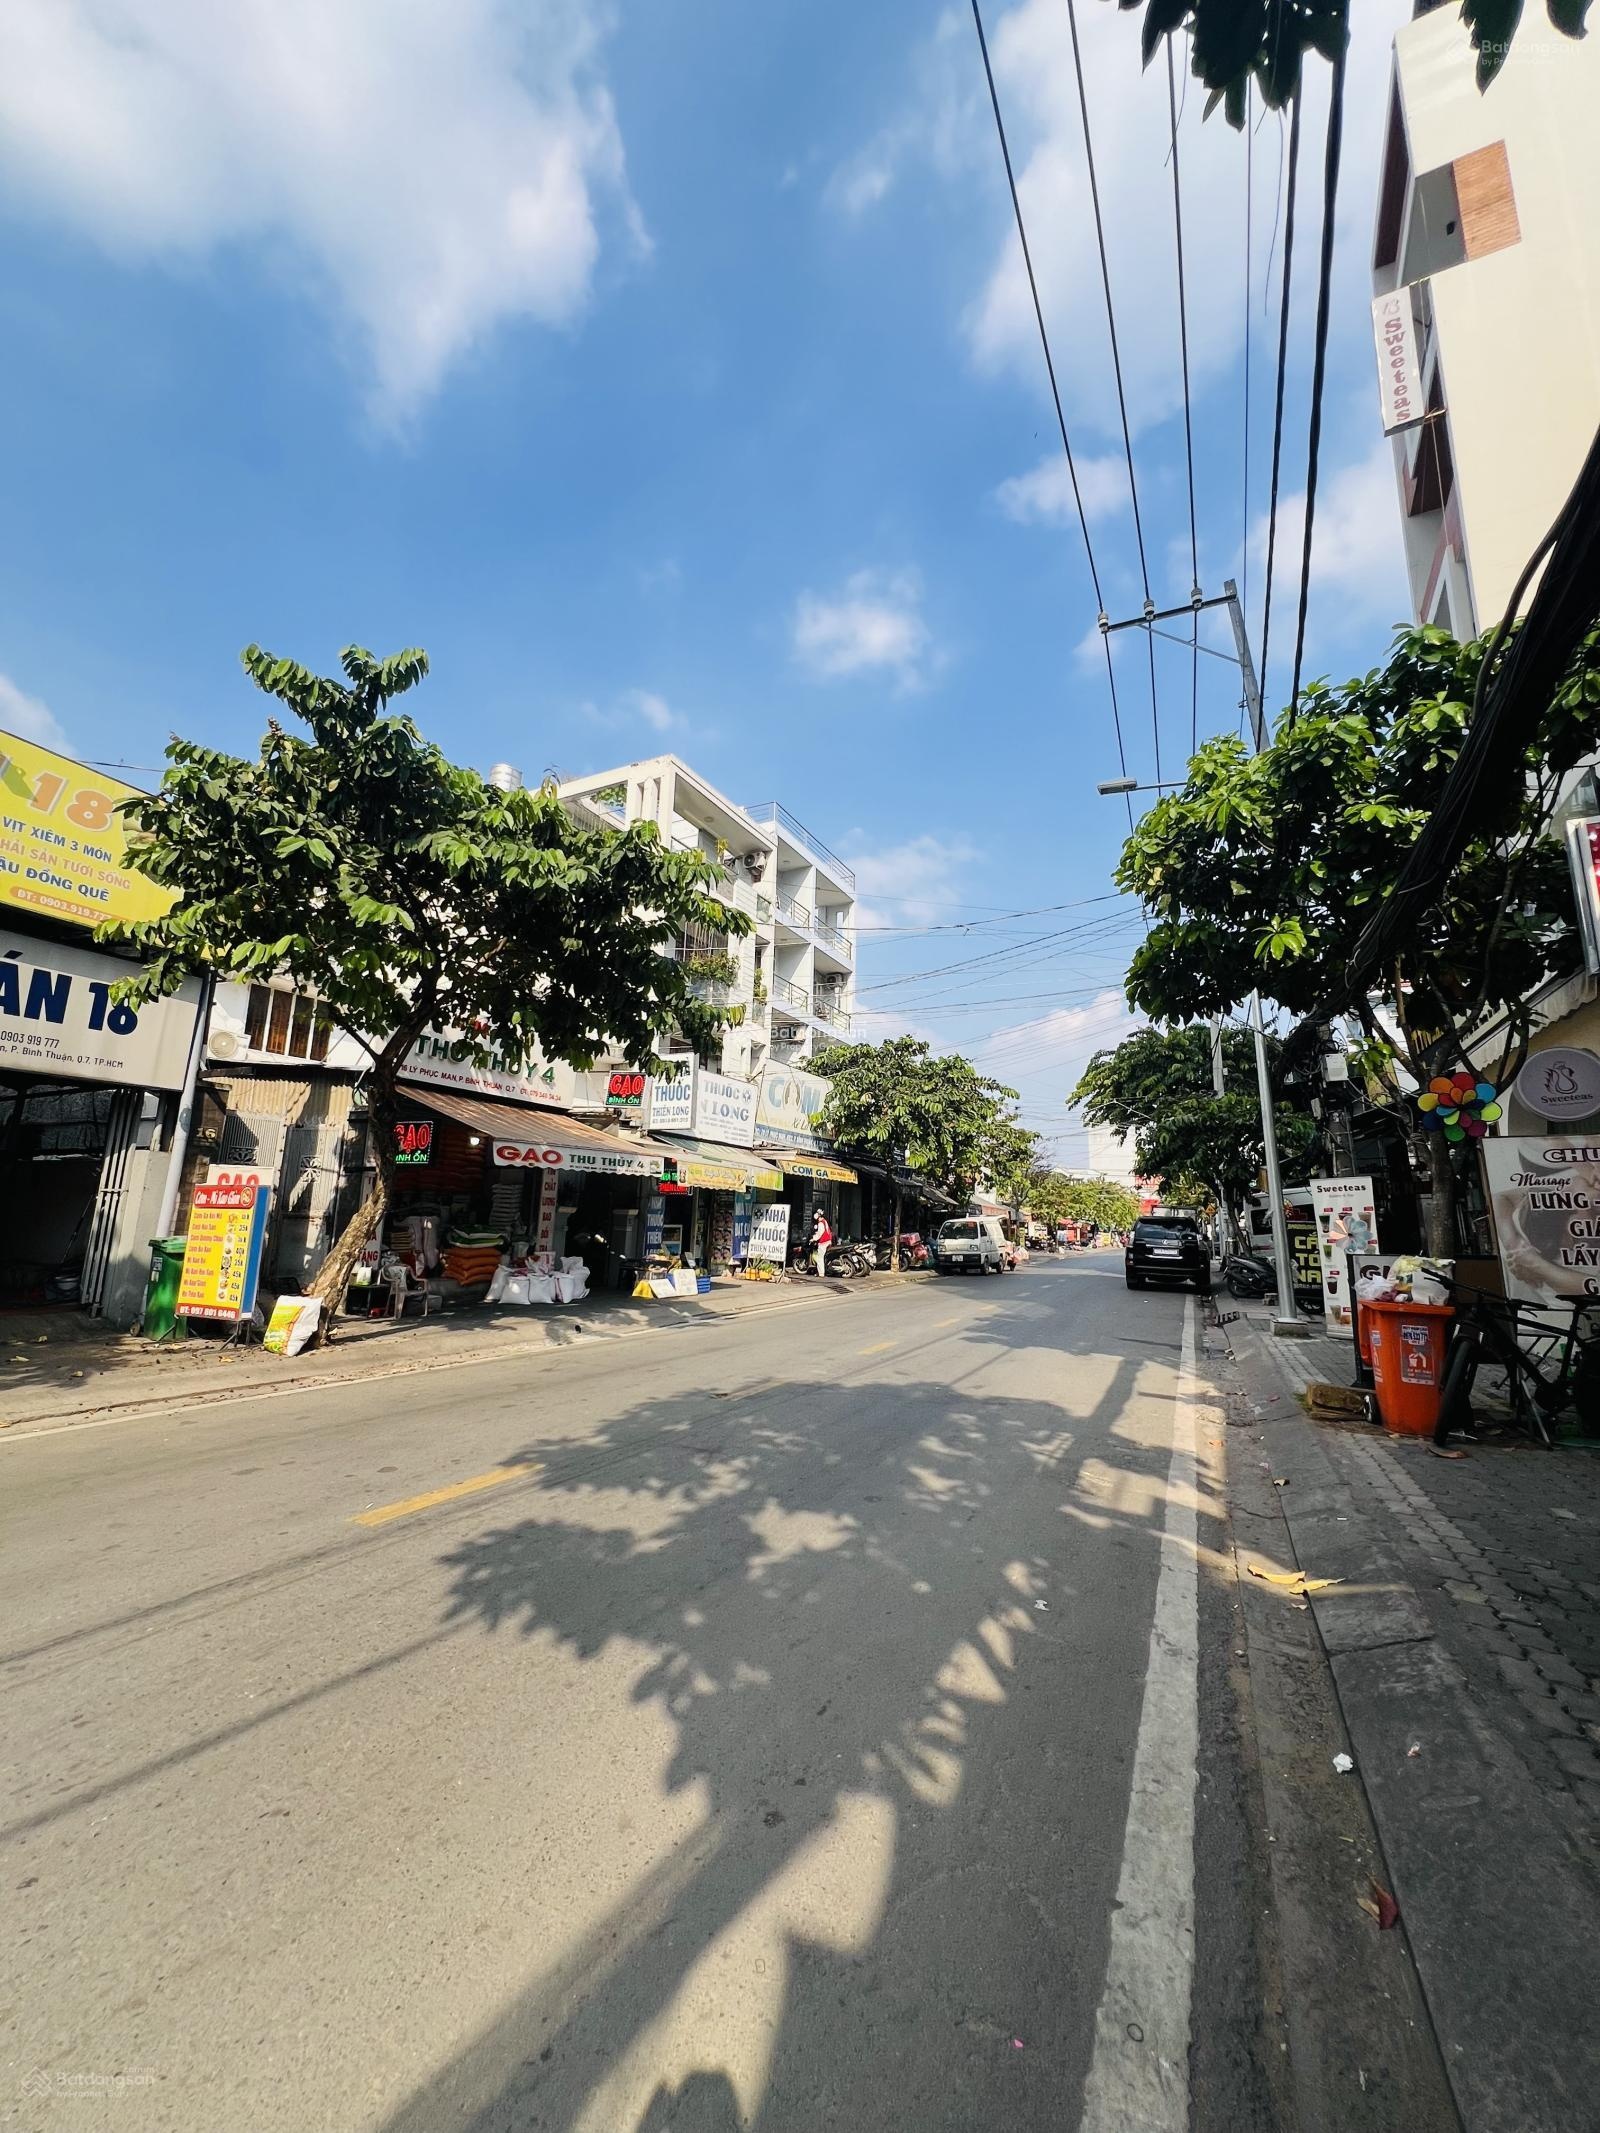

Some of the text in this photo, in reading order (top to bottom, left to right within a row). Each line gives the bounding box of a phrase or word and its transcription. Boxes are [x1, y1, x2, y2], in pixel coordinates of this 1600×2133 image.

[1384, 317, 1411, 421] Sweeteas
[29, 772, 113, 831] 18
[3, 816, 112, 862] VỊT XIÊM 3 MÓN
[26, 868, 73, 891] ĐỒNG
[78, 883, 110, 902] QUÊ
[88, 982, 138, 1035] 18
[1, 1030, 60, 1049] 0903 919 777
[11, 1045, 19, 1055] P.
[22, 1047, 42, 1057] Bình
[541, 1066, 556, 1083] 4
[610, 1074, 643, 1098] GẠO
[1540, 1093, 1594, 1104] Sweeteas
[672, 1106, 690, 1116] LONG
[496, 1145, 564, 1166] GẠO
[569, 1153, 596, 1165] THU
[637, 1159, 645, 1169] 4
[1316, 1184, 1367, 1194] Sweeteas
[1510, 1172, 1572, 1192] Massage
